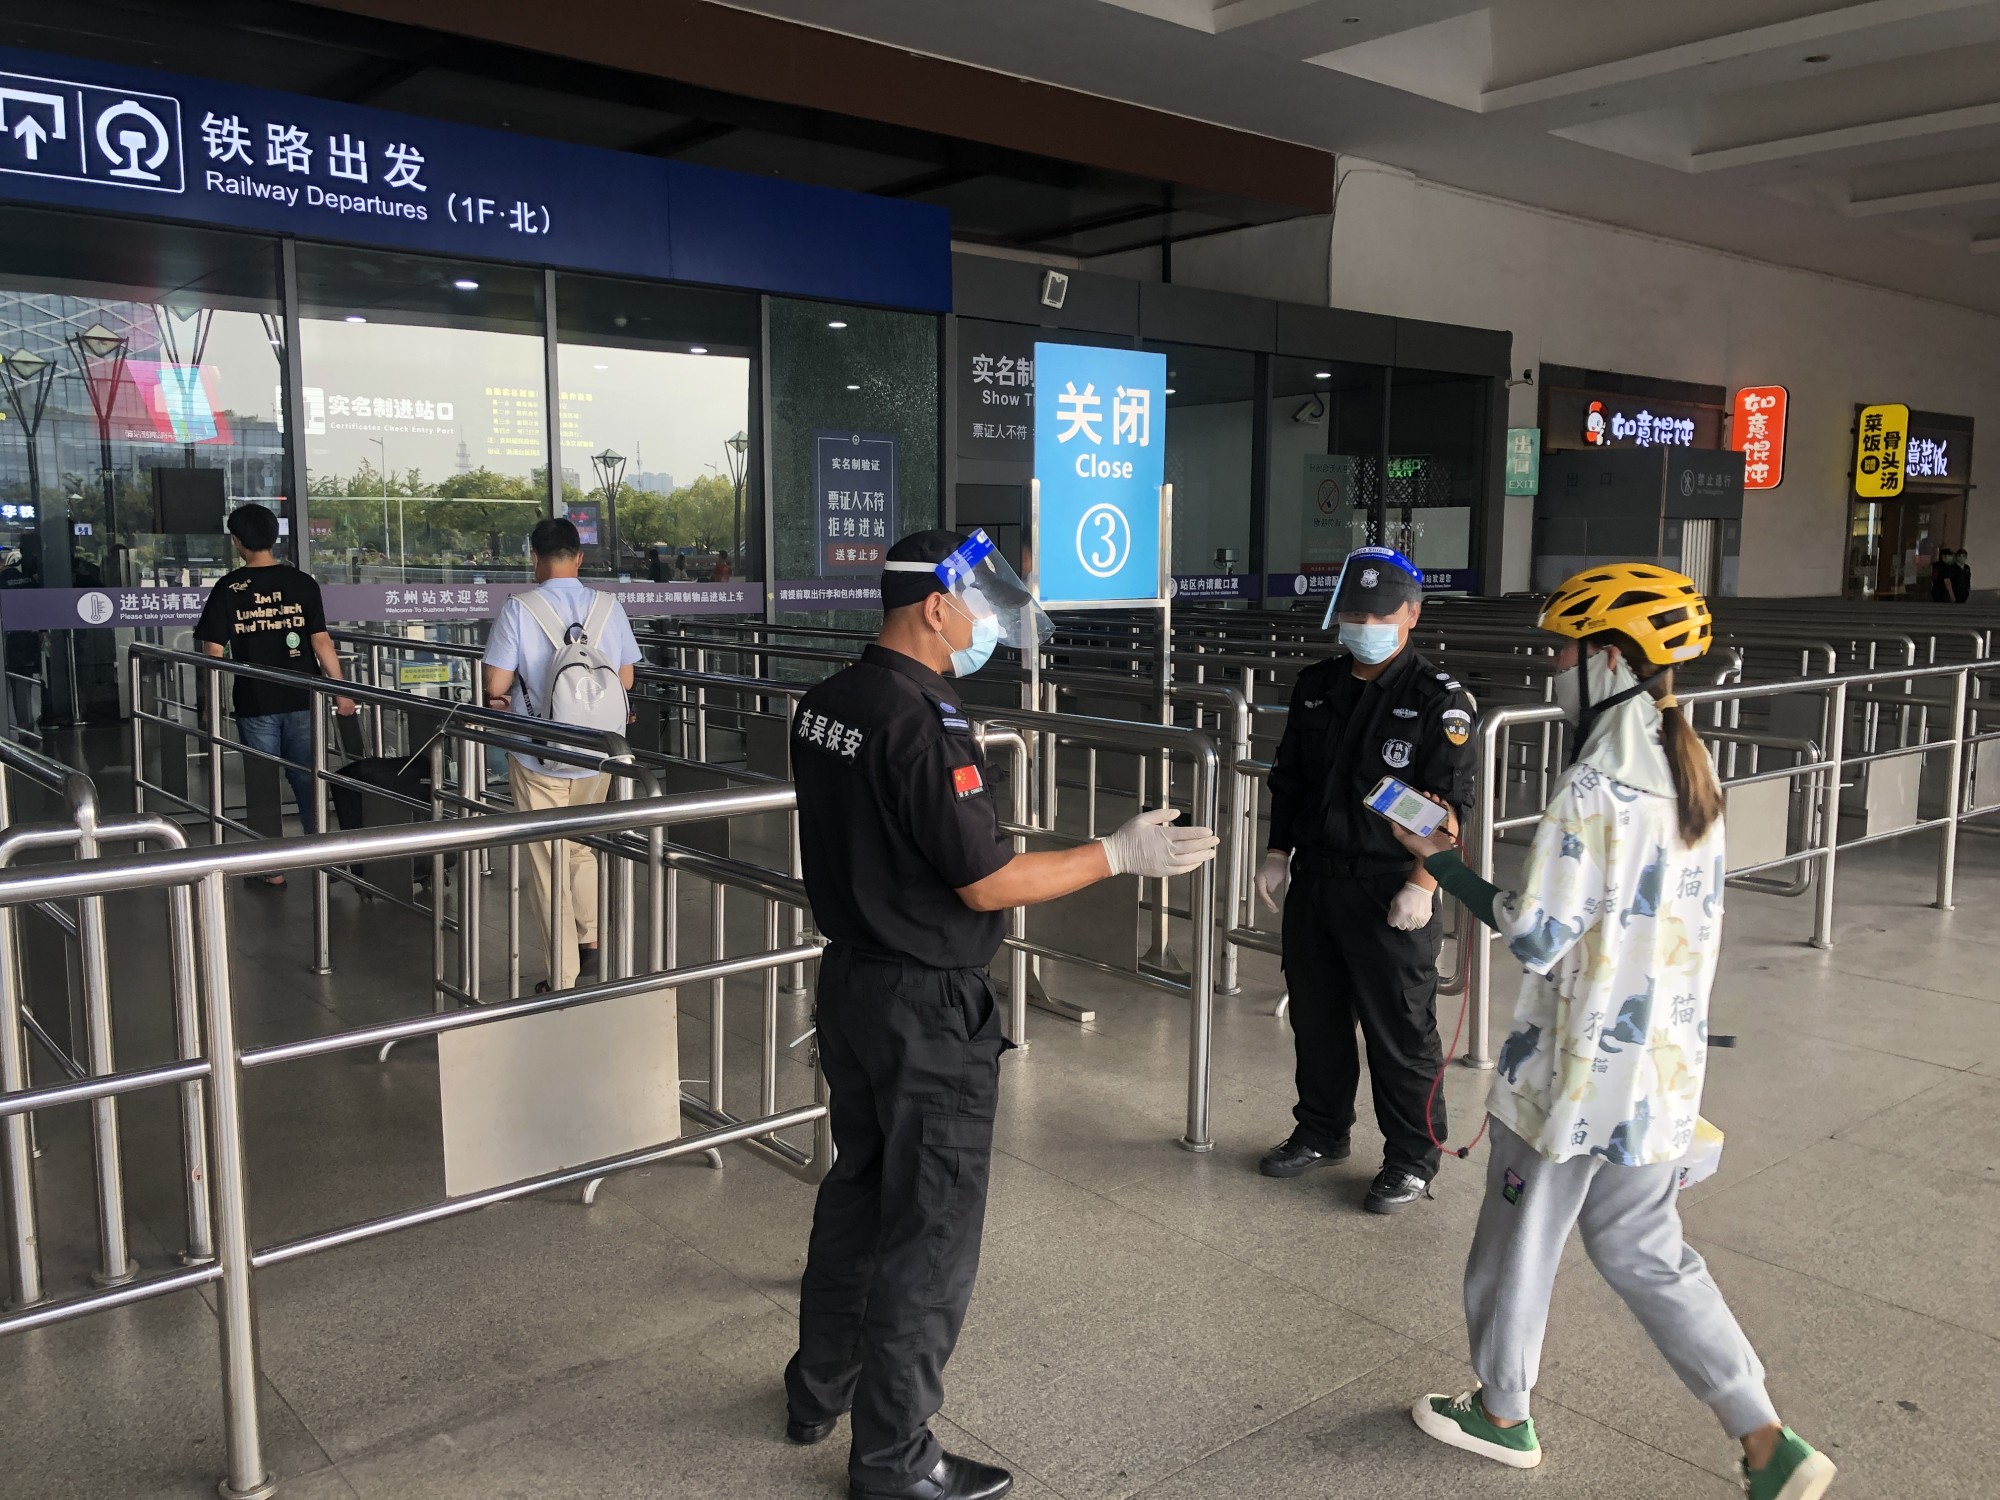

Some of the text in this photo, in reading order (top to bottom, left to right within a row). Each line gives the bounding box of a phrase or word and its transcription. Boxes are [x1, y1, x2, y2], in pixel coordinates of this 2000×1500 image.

[201, 111, 428, 192] 铁路出发
[206, 170, 428, 221] Railway Departures
[972, 353, 1035, 387] 实名制
[328, 394, 454, 421] 实名制进站口
[982, 389, 1020, 406] Show
[1056, 381, 1150, 447] 关闭
[330, 421, 455, 435] Certificates Check Entry Port
[972, 422, 1028, 440] 票证人不符
[1612, 410, 1695, 447] 如意馄饨
[1863, 413, 1883, 452] 菜饭
[831, 457, 881, 471] 实名制验证
[1075, 453, 1133, 479] Close
[1514, 435, 1532, 474] 出口
[1880, 431, 1901, 490] 骨头汤
[1388, 470, 1413, 478] EXIT
[1508, 479, 1535, 489] EXIT
[827, 490, 885, 511] 票证人不符
[827, 517, 885, 538] 拒绝进站
[835, 548, 879, 561] 送客止步
[385, 589, 489, 605] 苏州站欢迎您
[1180, 577, 1239, 591] 站区内请戴口罩
[798, 709, 864, 758] 东吴保安
[1677, 865, 1704, 899] 猫
[1670, 993, 1697, 1026] 猫
[1591, 1057, 1609, 1074] 猫
